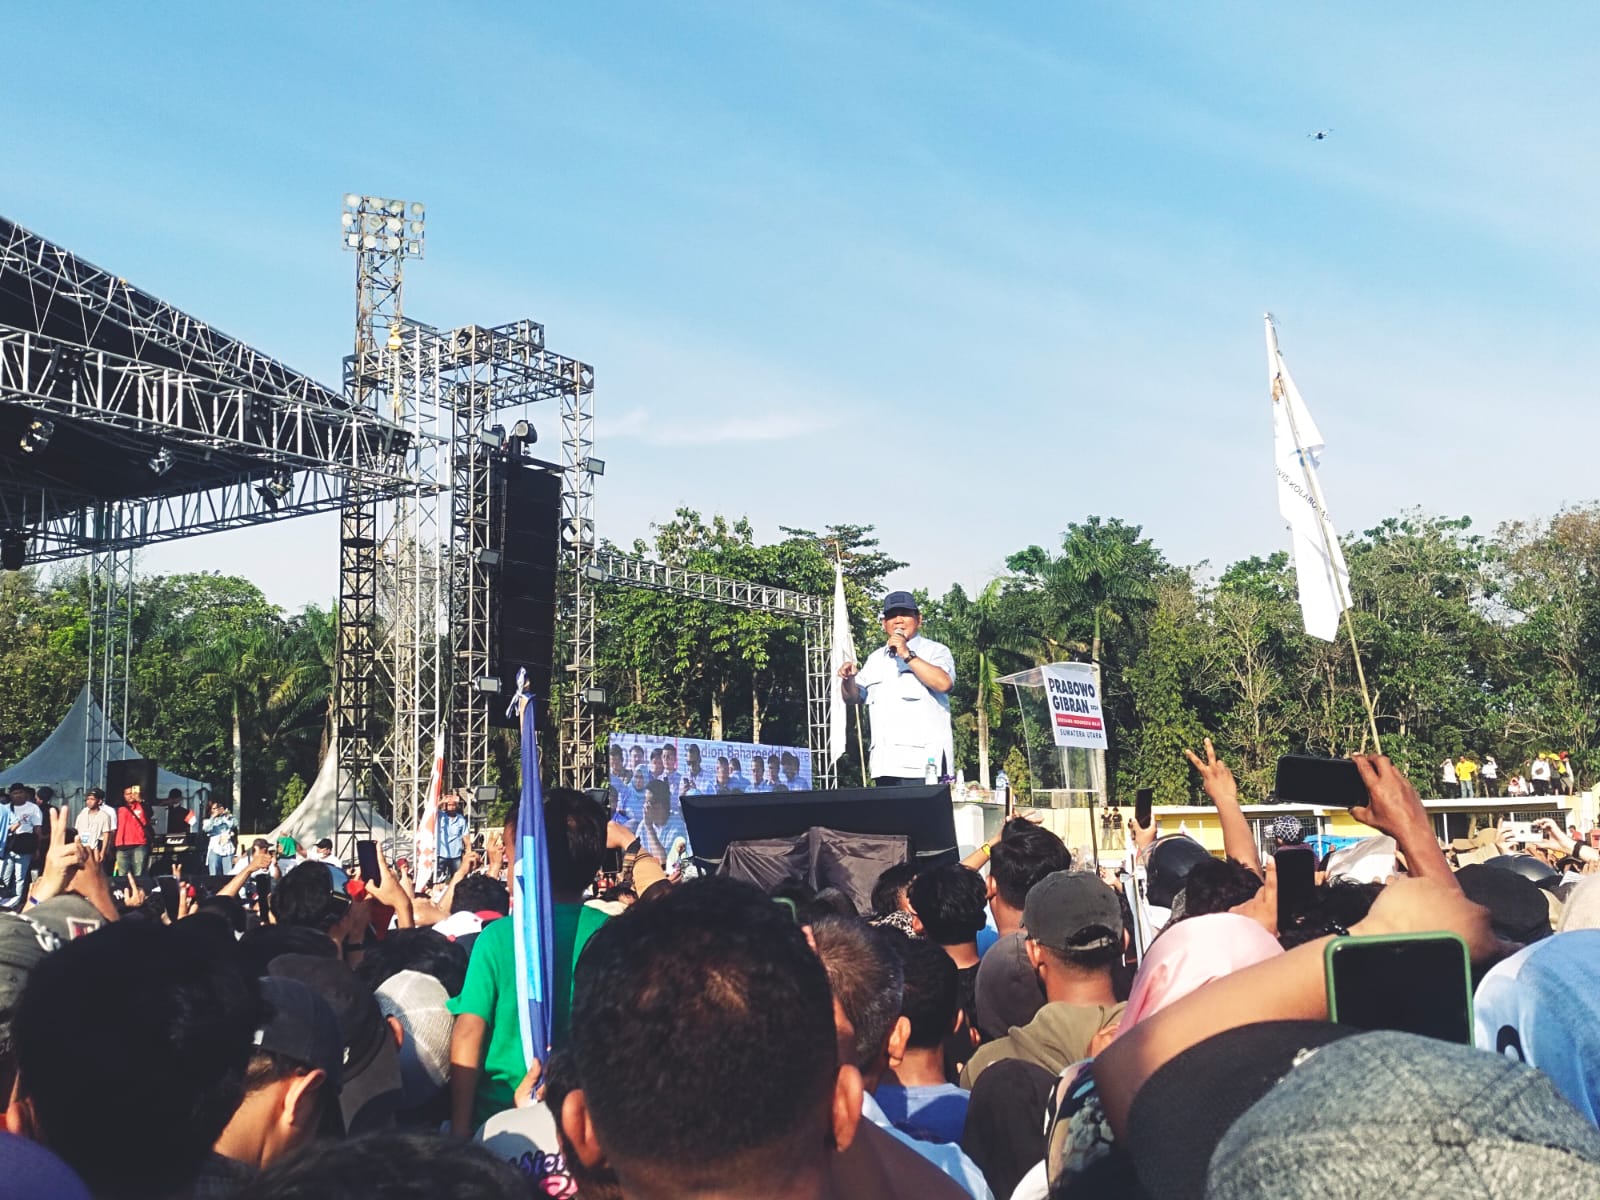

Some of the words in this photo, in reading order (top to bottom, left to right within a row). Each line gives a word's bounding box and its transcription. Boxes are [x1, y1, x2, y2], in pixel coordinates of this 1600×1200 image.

[1048, 678, 1095, 698] PRABOWO
[1053, 695, 1090, 714] GIBRAN
[1060, 729, 1085, 737] SUMATERA
